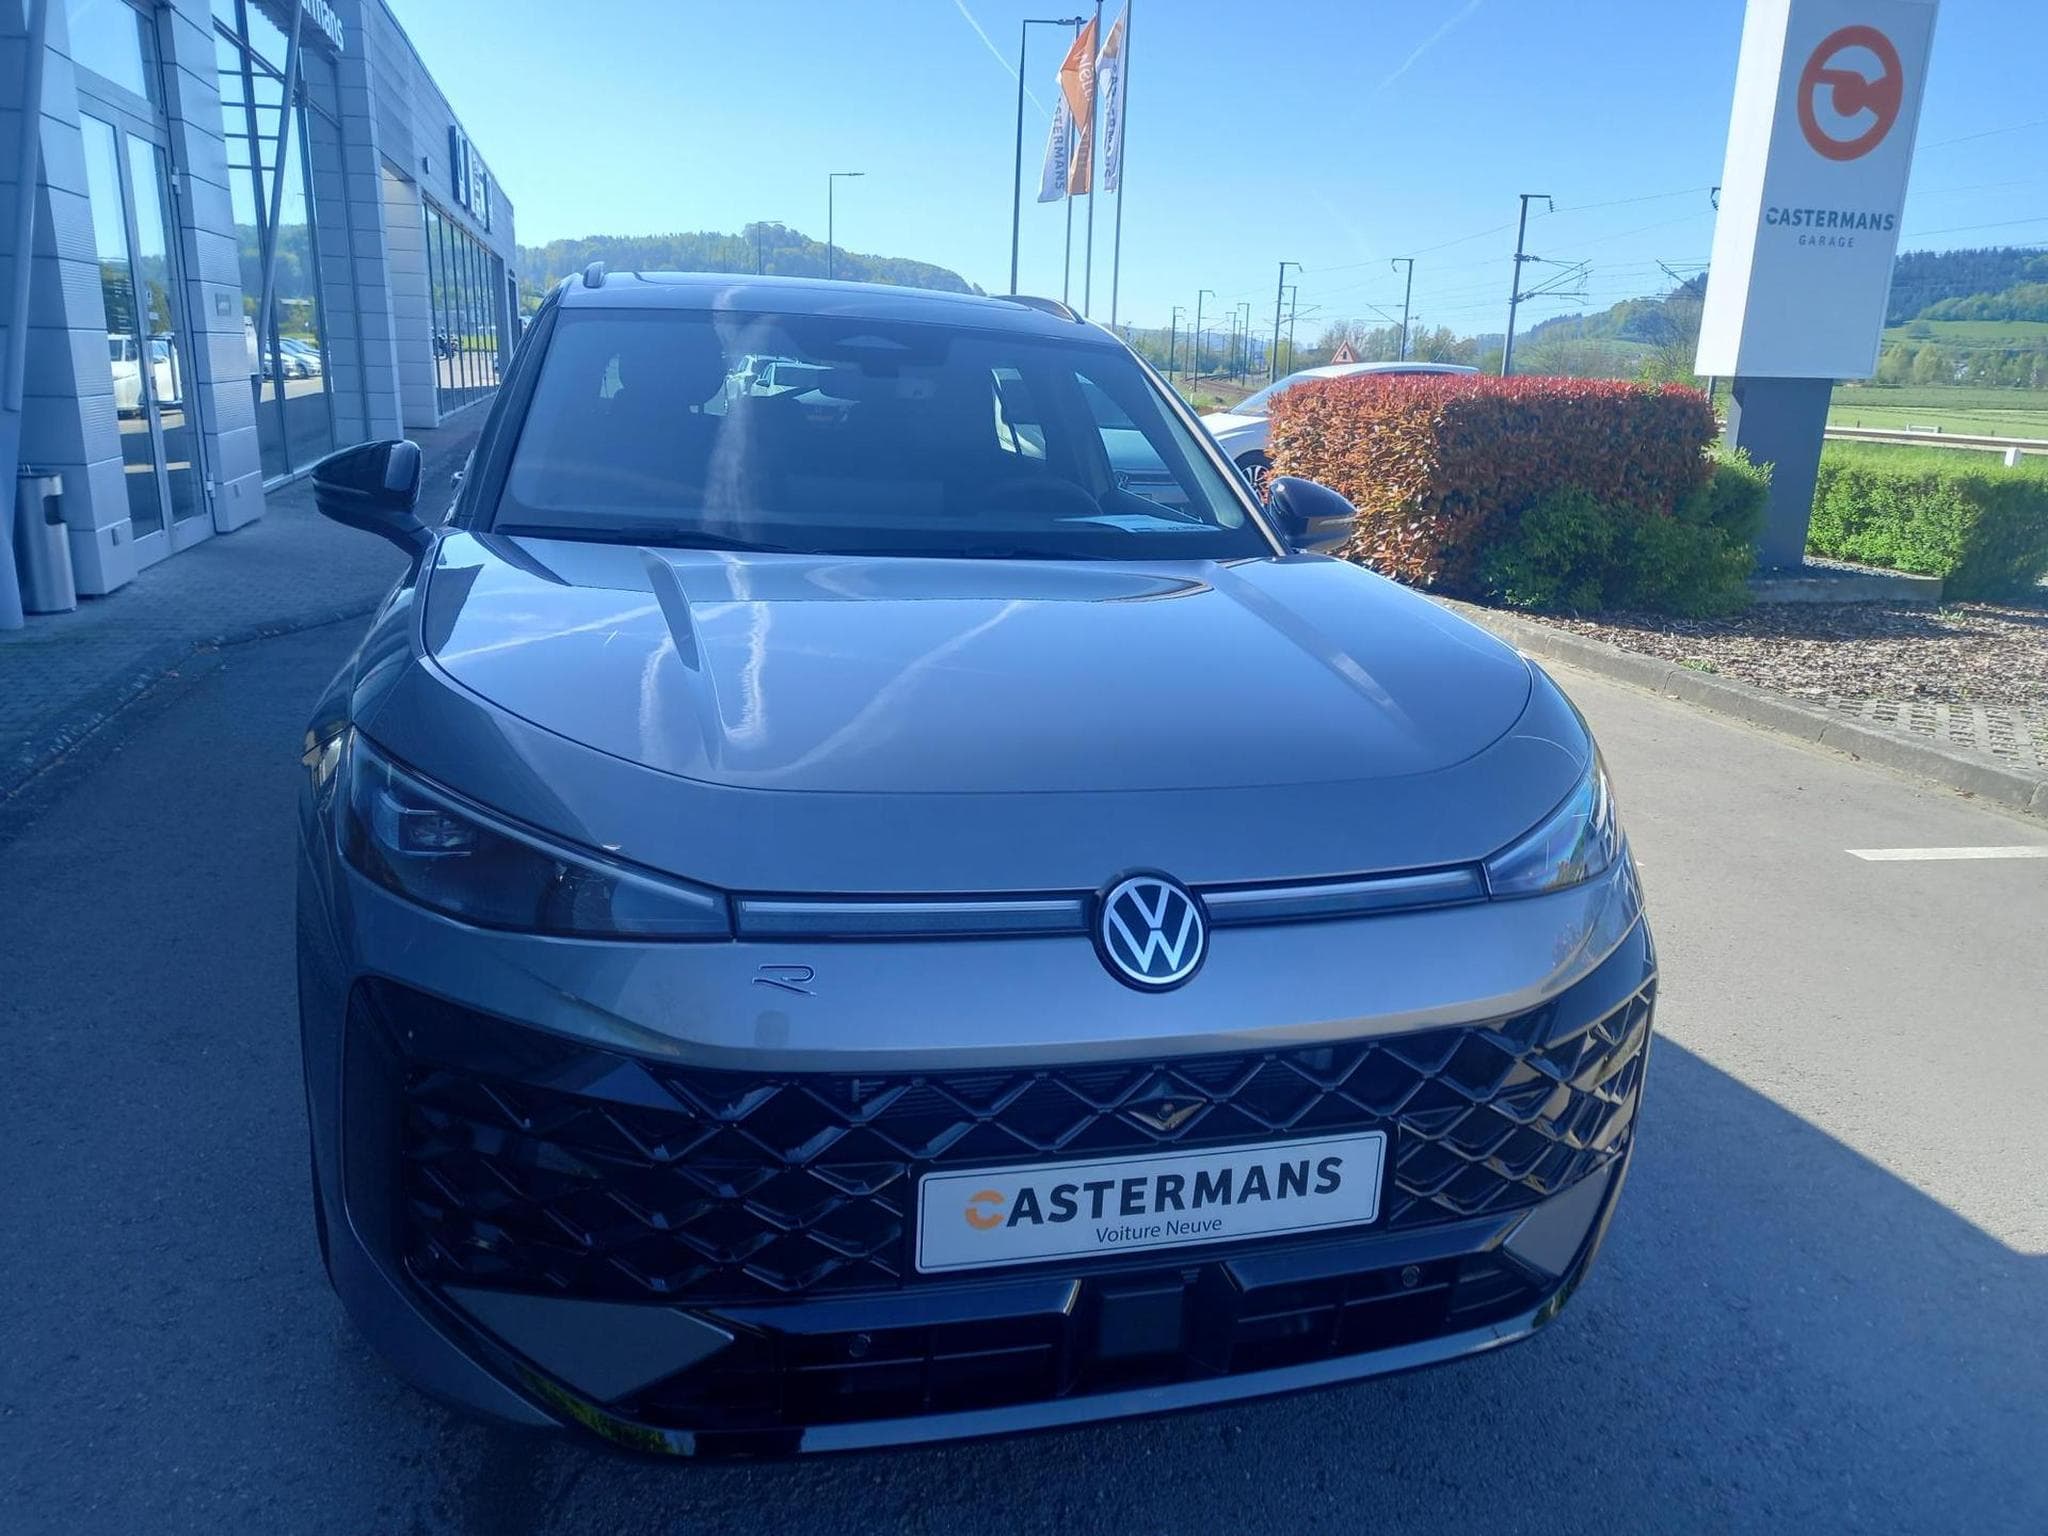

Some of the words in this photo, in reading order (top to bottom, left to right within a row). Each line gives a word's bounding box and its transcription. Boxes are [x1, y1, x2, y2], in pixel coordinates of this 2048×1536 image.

[1766, 207, 1895, 231] CASTERMANS
[1798, 235, 1855, 248] GARAGE
[965, 1156, 1343, 1230] CASTERMANS
[1095, 1222, 1161, 1244] Voiture
[1165, 1217, 1223, 1237] Neuve
